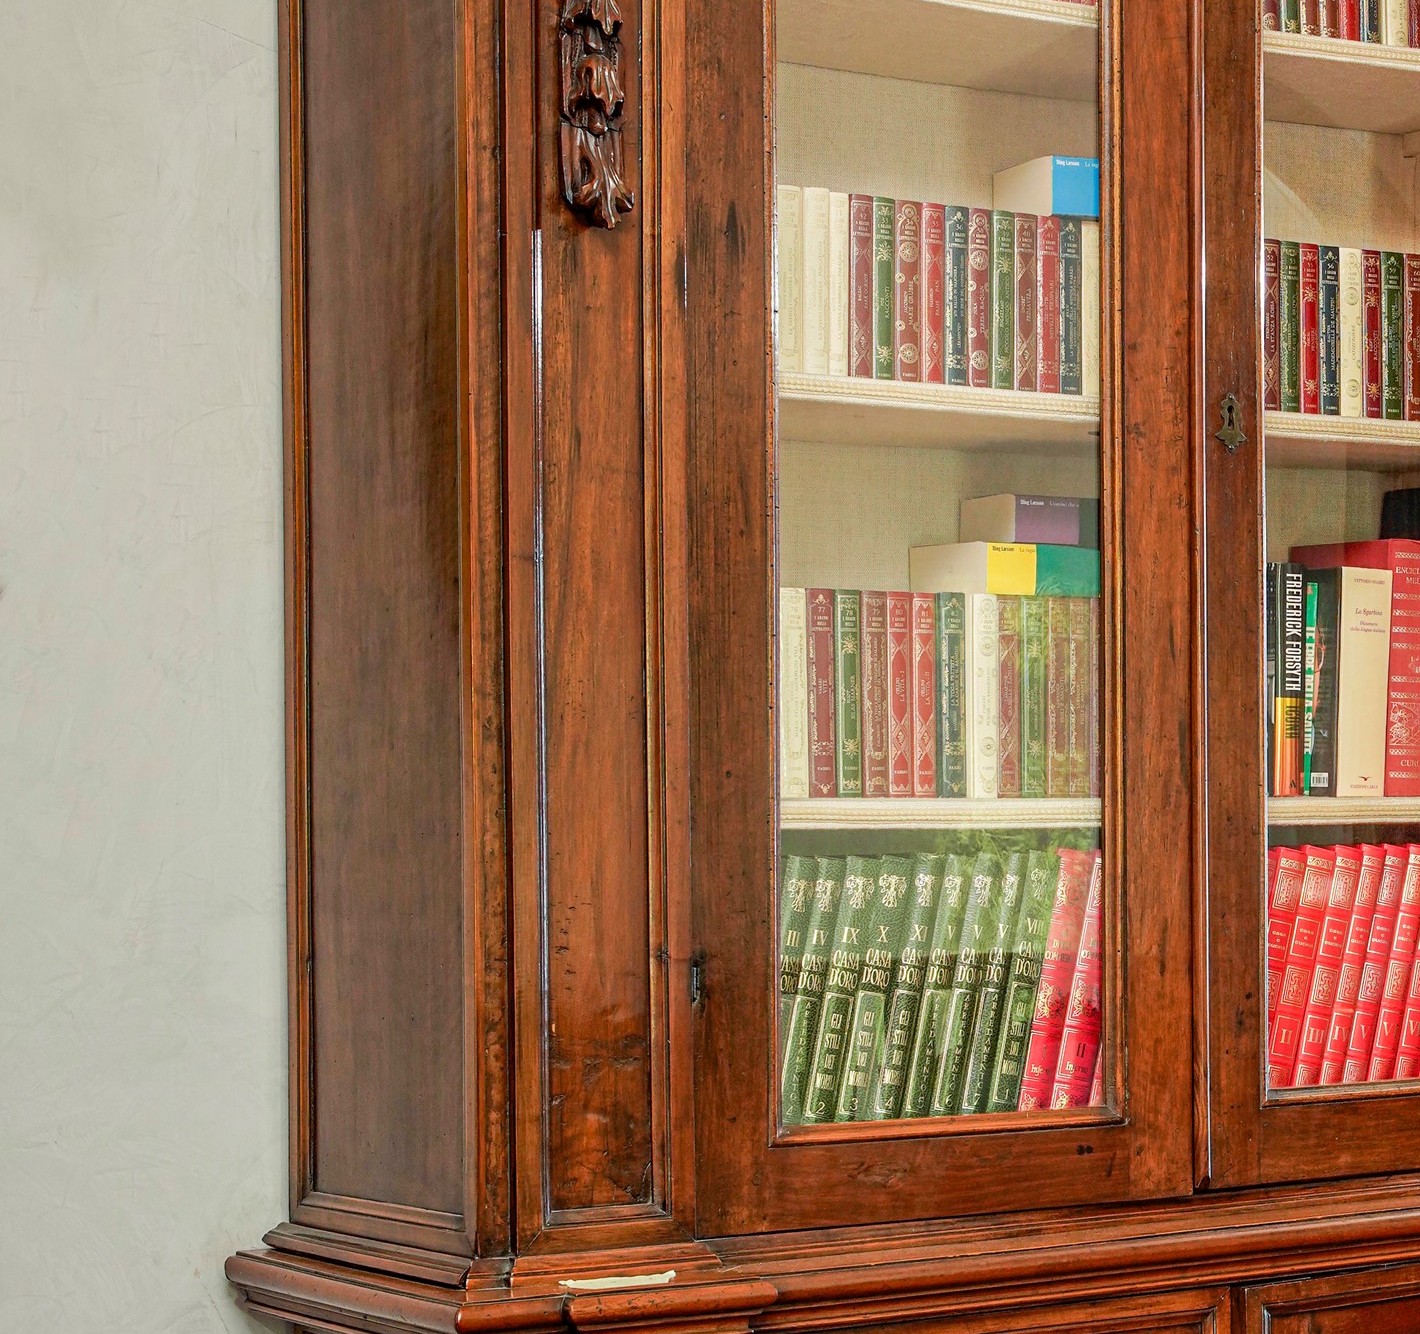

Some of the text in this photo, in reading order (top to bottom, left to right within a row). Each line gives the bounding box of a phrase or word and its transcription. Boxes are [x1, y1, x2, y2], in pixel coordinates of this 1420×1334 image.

[1285, 573, 1303, 691] FREDERICK FORSYTH
[785, 929, 800, 947] III
[812, 929, 828, 946] IV
[841, 926, 860, 945] IX
[877, 925, 890, 943] X
[780, 954, 800, 973] ASA
[833, 949, 860, 970] CASA
[865, 948, 892, 968] CASA
[829, 968, 858, 991] D'ORO
[861, 966, 890, 990] D'ORO
[1279, 1028, 1292, 1045] II
[1307, 1027, 1325, 1044] III
[1332, 1025, 1349, 1041] IV
[1359, 1024, 1371, 1040] V
[1076, 1042, 1087, 1058] II
[816, 1101, 825, 1115] 2
[850, 1097, 859, 1111] 3
[885, 1096, 894, 1110] 4
[945, 1093, 952, 1107] 6
[973, 1093, 981, 1106] 7
